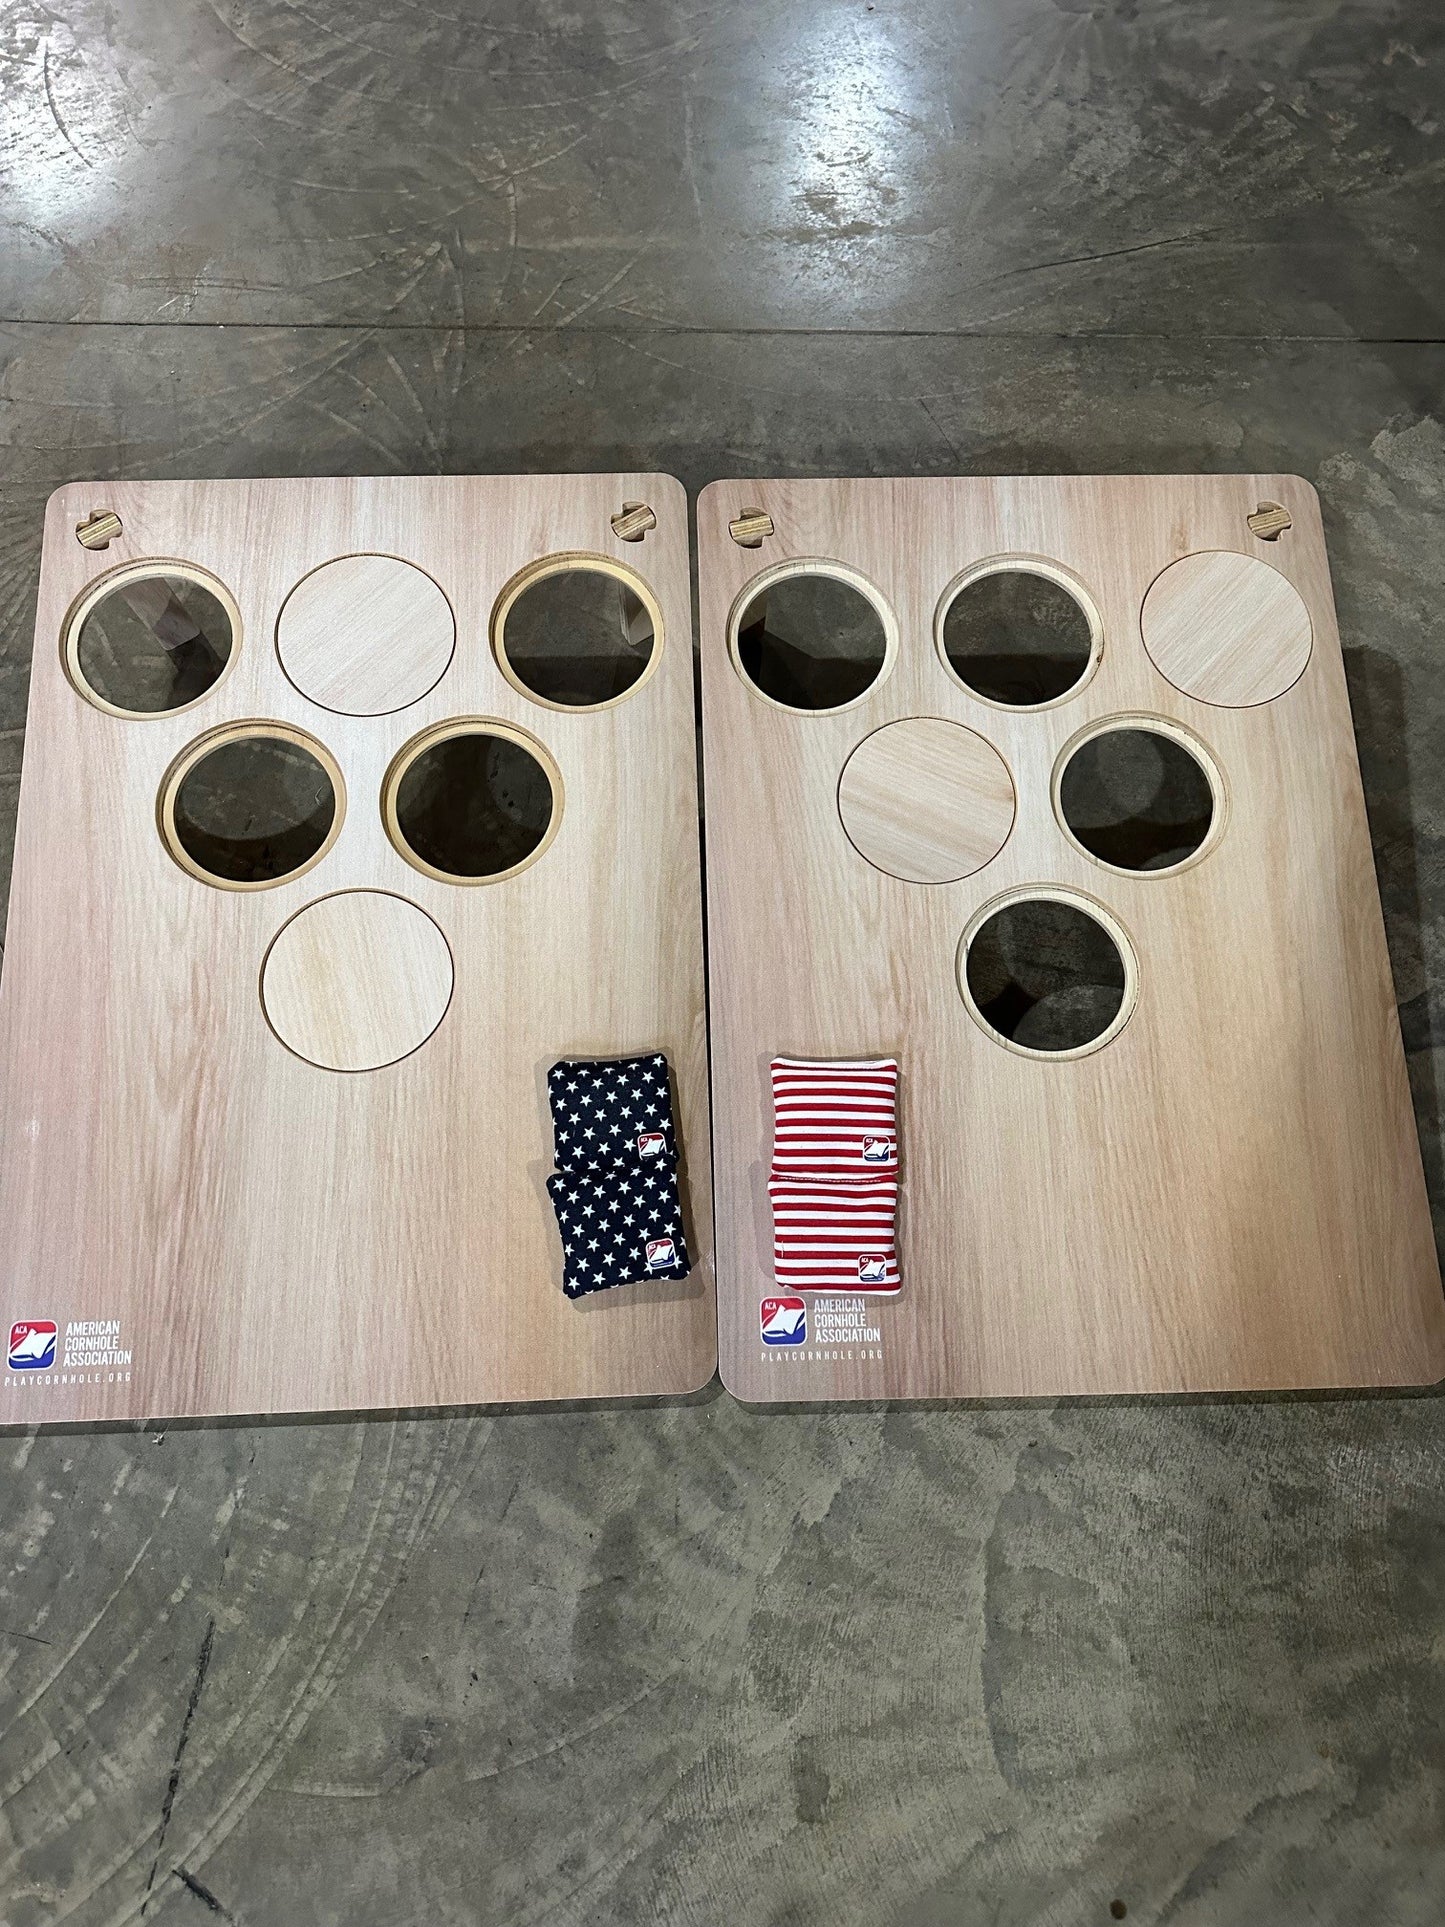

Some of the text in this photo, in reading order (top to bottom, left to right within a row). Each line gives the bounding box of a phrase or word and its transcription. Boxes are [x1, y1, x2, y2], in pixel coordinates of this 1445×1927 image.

[764, 1302, 777, 1310] ACA
[814, 1298, 866, 1313] AMERICAN
[66, 1320, 120, 1336] AMERICAN
[815, 1313, 866, 1328] CORNHOLE
[15, 1326, 28, 1334] ACA
[815, 1328, 881, 1343] ASSOCIATION
[65, 1336, 119, 1351] CORNHOLE
[63, 1350, 132, 1367] ASSOCIATION
[761, 1349, 883, 1362] PLAYCORNHOLE.ORG
[4, 1372, 131, 1387] PLAYCORNHOLE.ORG
